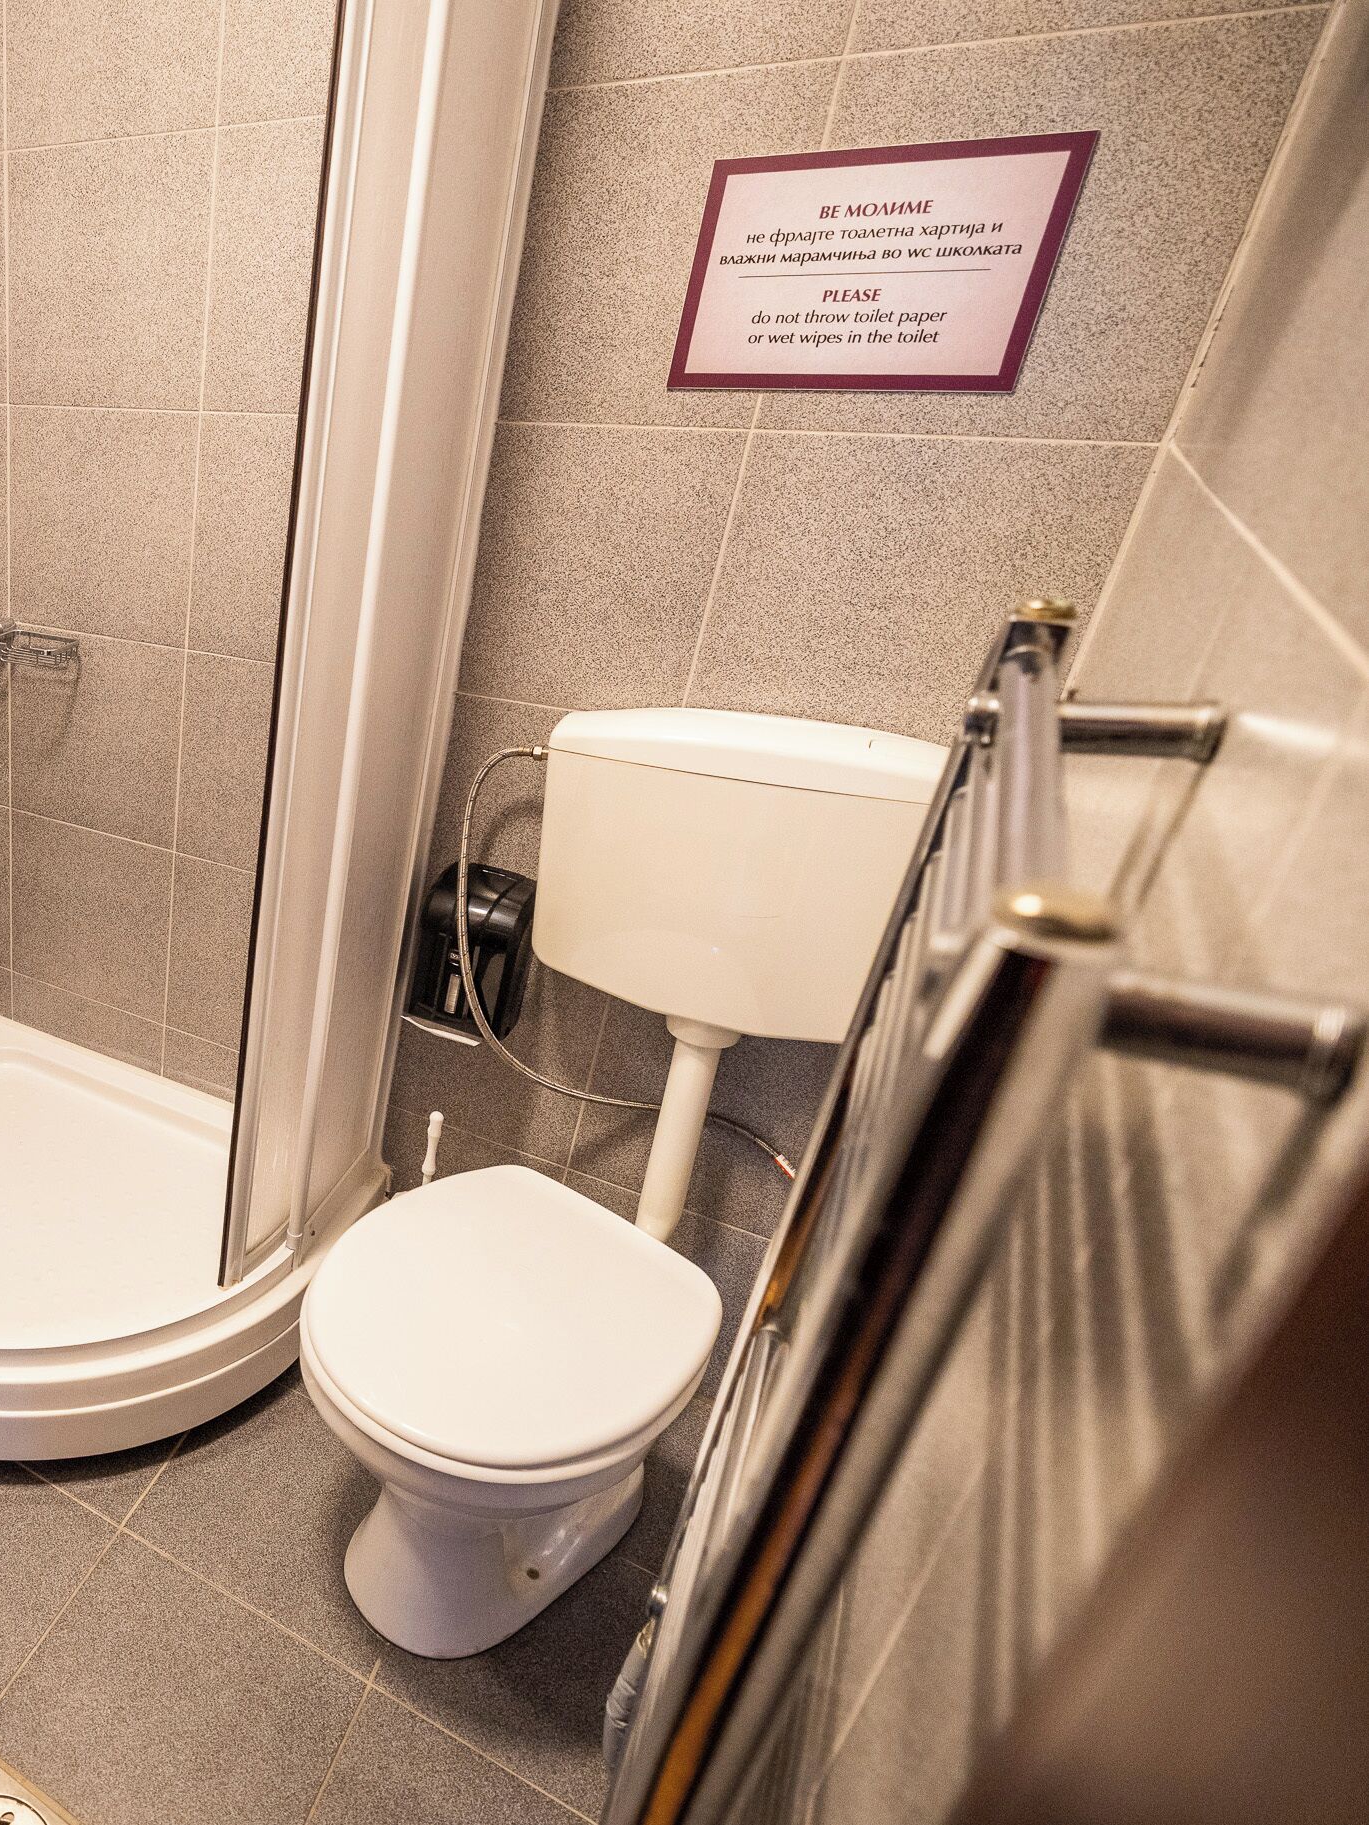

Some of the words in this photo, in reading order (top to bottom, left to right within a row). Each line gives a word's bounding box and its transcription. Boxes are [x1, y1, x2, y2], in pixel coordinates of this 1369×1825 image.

[819, 205, 841, 219] ВЕ
[844, 200, 934, 218] МОЛИМЕ
[746, 233, 765, 244] не
[769, 228, 835, 247] фрлајте
[840, 226, 914, 240] тоалетна
[919, 222, 986, 240] хартија
[991, 222, 1004, 233] и
[719, 253, 776, 265] влажни
[780, 249, 876, 267] марамчиња
[881, 249, 902, 259] во
[936, 243, 1023, 258] школката
[822, 288, 882, 303] PLEASE
[751, 310, 771, 324] do
[775, 312, 801, 324] not
[804, 309, 851, 324] throw
[853, 308, 894, 323] toilet
[897, 310, 948, 327] paper
[747, 333, 764, 344] or
[768, 332, 795, 344] wet
[799, 331, 843, 348] wipes
[847, 330, 862, 343] in
[867, 329, 893, 343] the
[897, 329, 940, 343] toilet
